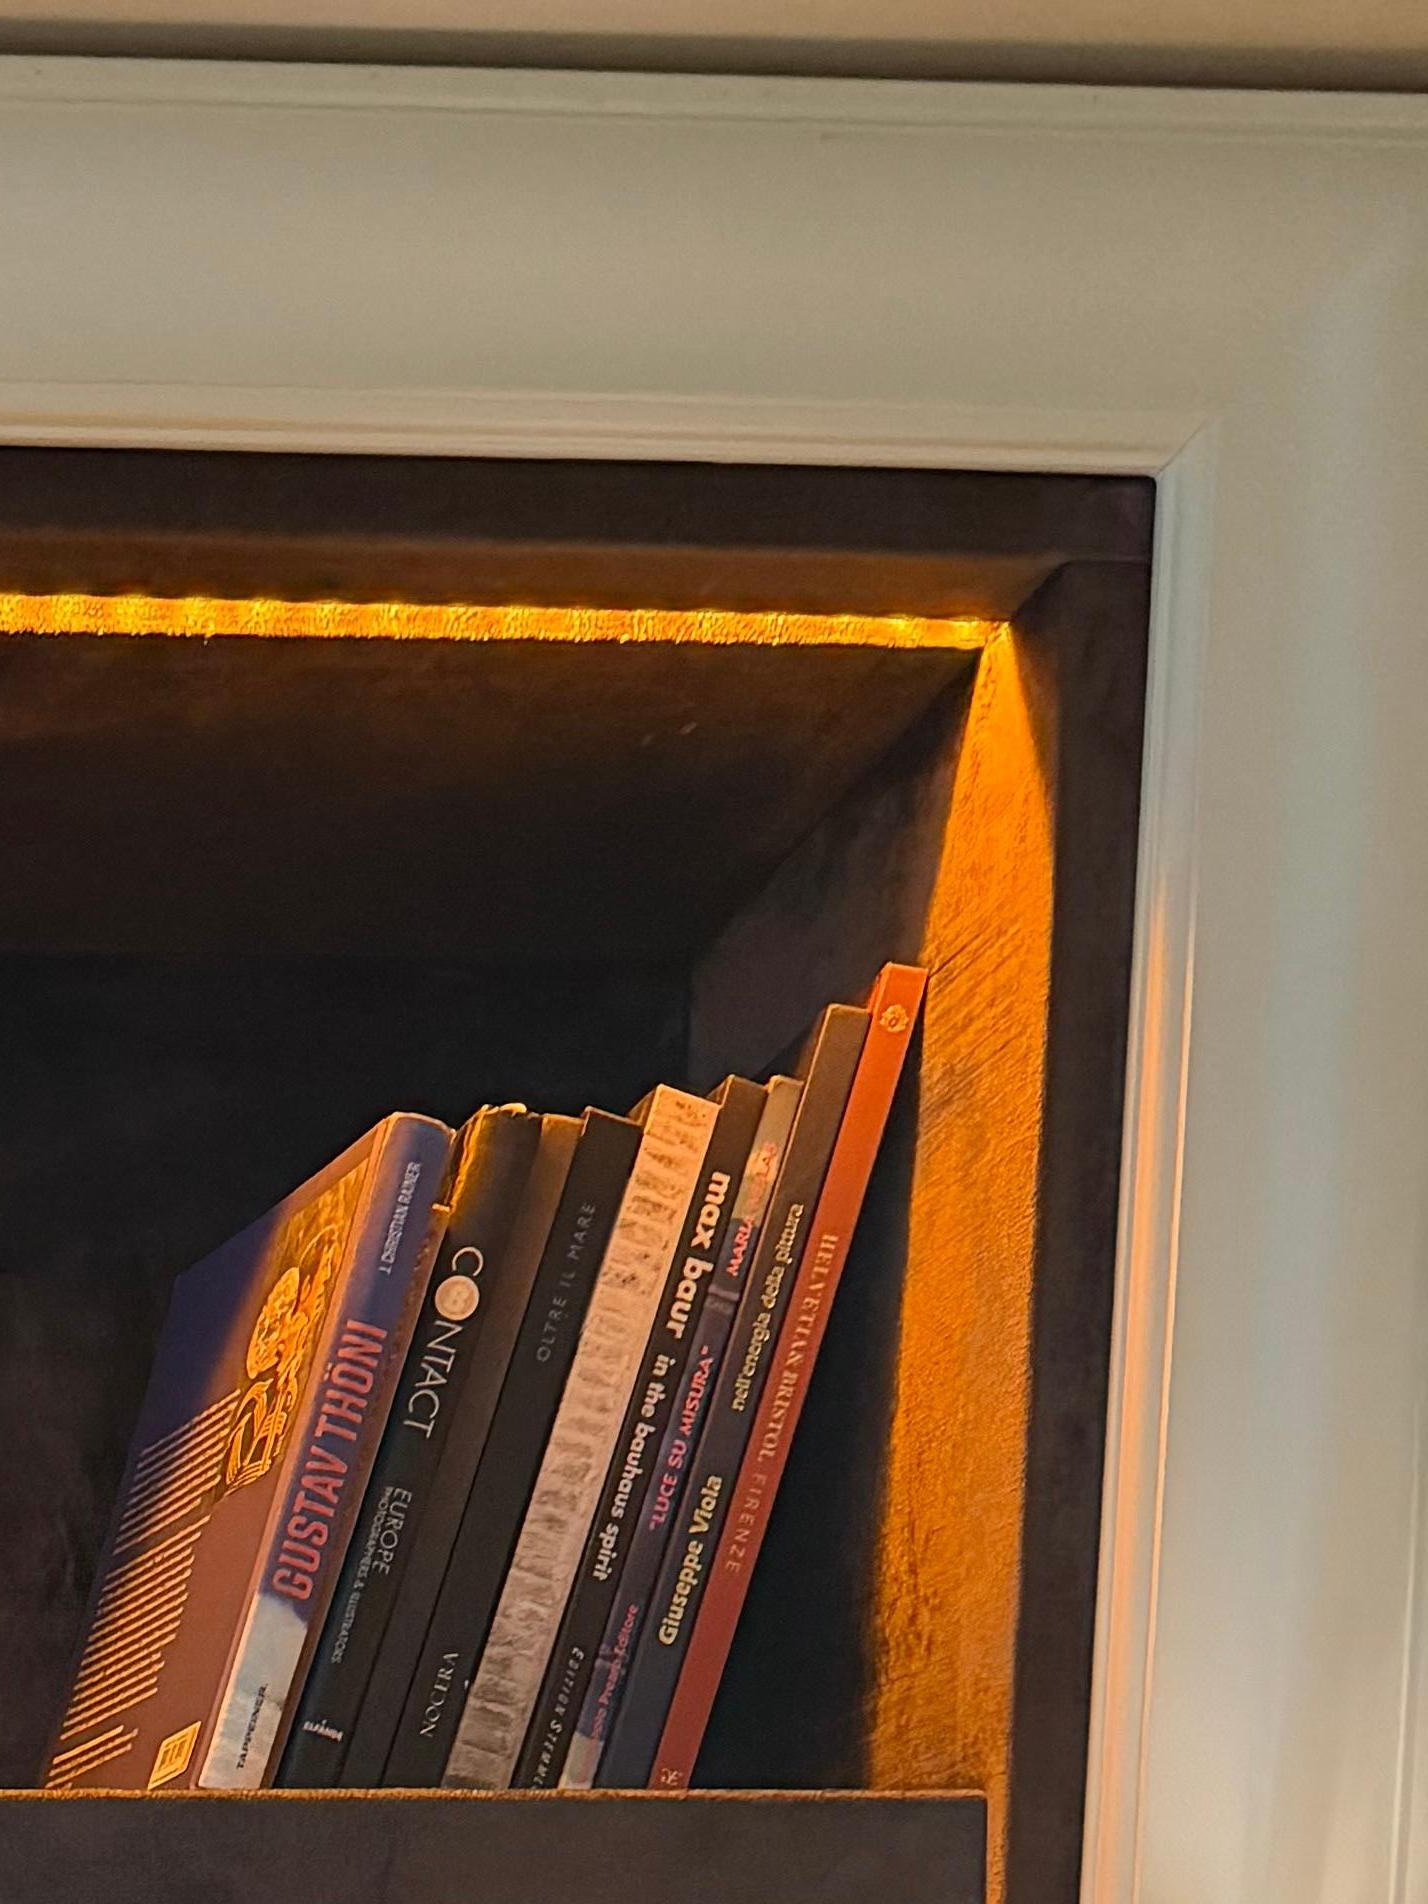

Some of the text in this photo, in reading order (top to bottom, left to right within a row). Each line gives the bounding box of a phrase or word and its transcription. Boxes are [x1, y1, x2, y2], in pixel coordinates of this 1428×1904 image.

[403, 1246, 484, 1440] CONTACT
[536, 1201, 595, 1363] OLTRE IL MARE
[593, 1170, 731, 1582] max baur in the bauhaus spirit
[658, 1540, 705, 1645] Giuseppe
[688, 1475, 723, 1535] Viola
[761, 1263, 786, 1309] della
[775, 1203, 804, 1266] pittura
[668, 1438, 687, 1468] SU
[272, 1319, 389, 1601] GUSTAV THÖNI
[372, 1486, 412, 1576] EUROPE
[724, 1472, 769, 1574] FIRENZE
[419, 1652, 460, 1739] NOCERA
